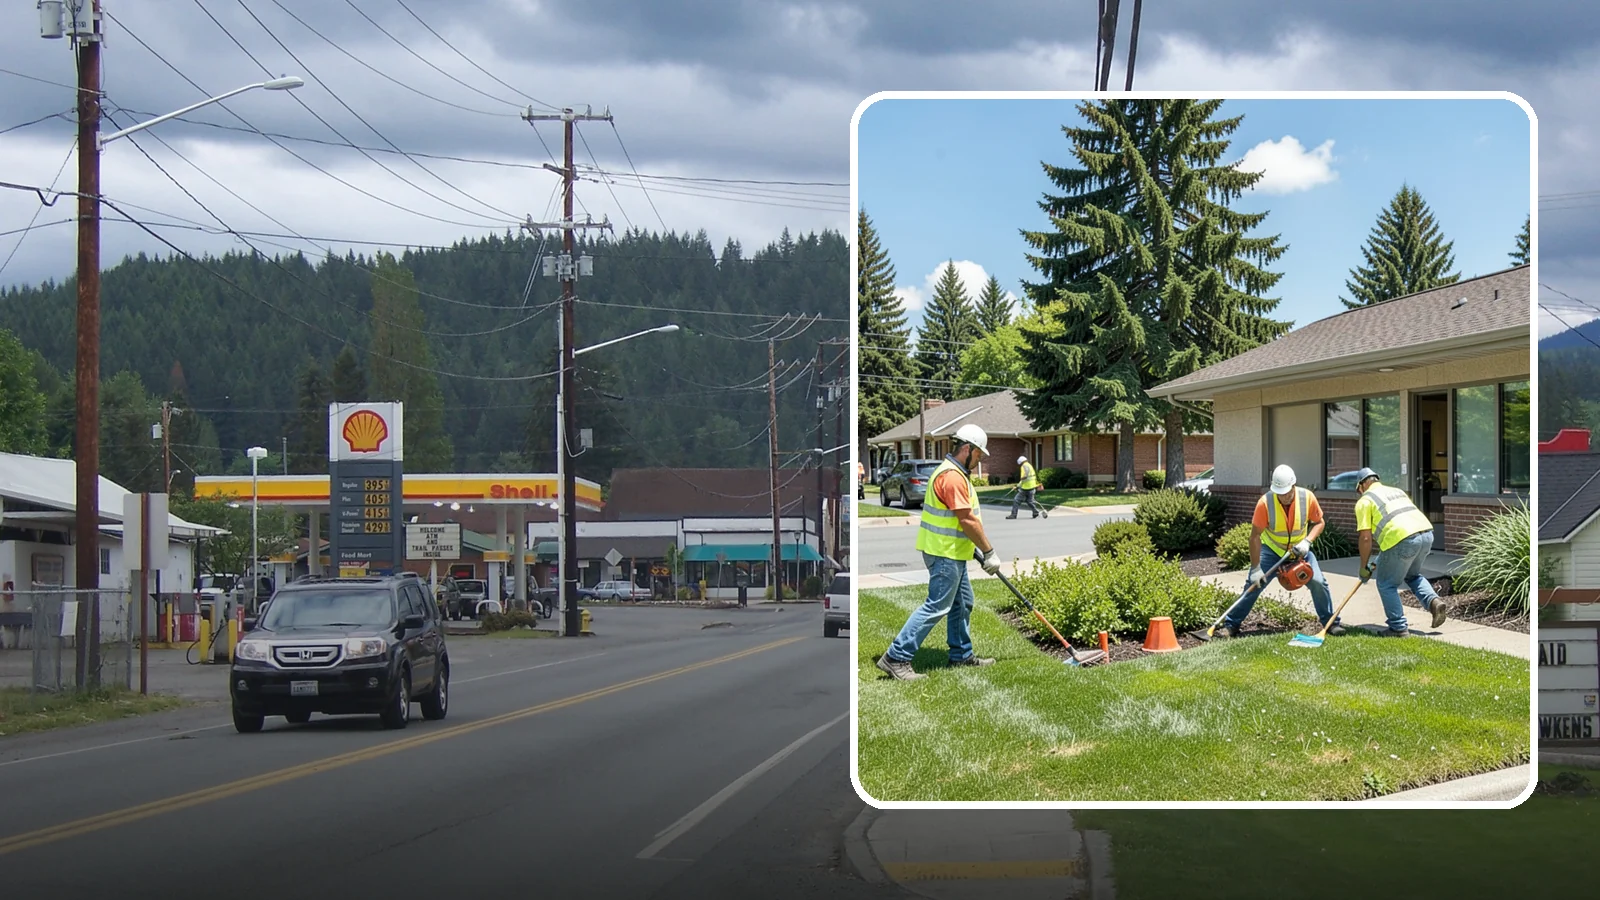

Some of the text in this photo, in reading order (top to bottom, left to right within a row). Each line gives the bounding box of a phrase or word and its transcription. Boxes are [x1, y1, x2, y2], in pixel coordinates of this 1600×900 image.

[366, 480, 384, 490] 395
[490, 484, 547, 499] Shell
[366, 494, 384, 504] 405
[366, 508, 384, 518] 415
[366, 522, 384, 532] 429
